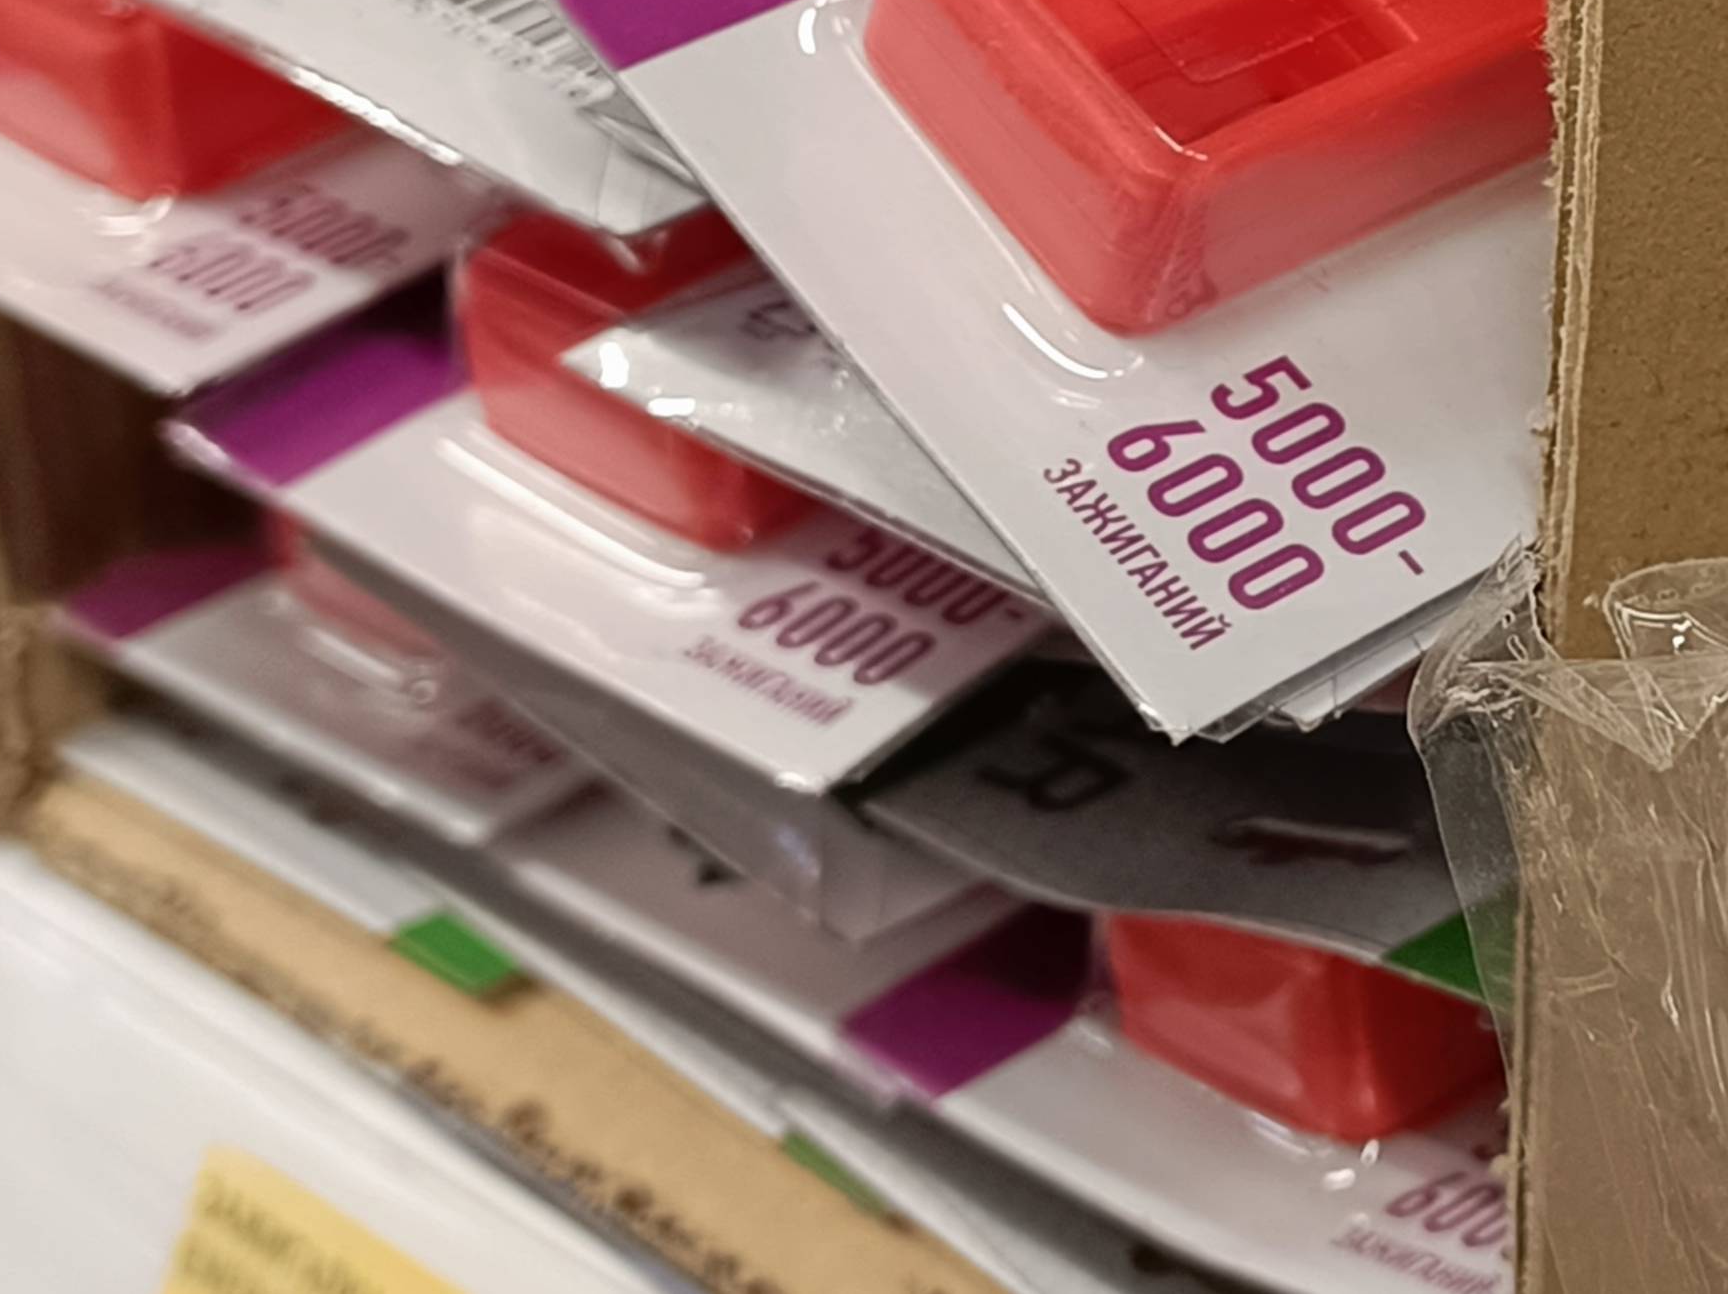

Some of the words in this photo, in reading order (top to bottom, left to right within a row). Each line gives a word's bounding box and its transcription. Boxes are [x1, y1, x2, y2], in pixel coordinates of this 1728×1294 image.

[1043, 458, 1233, 651] ЗАЖИГАНИЙ
[1107, 420, 1325, 611] 6000
[1211, 354, 1426, 576] 5000-
[737, 579, 936, 687] 6000
